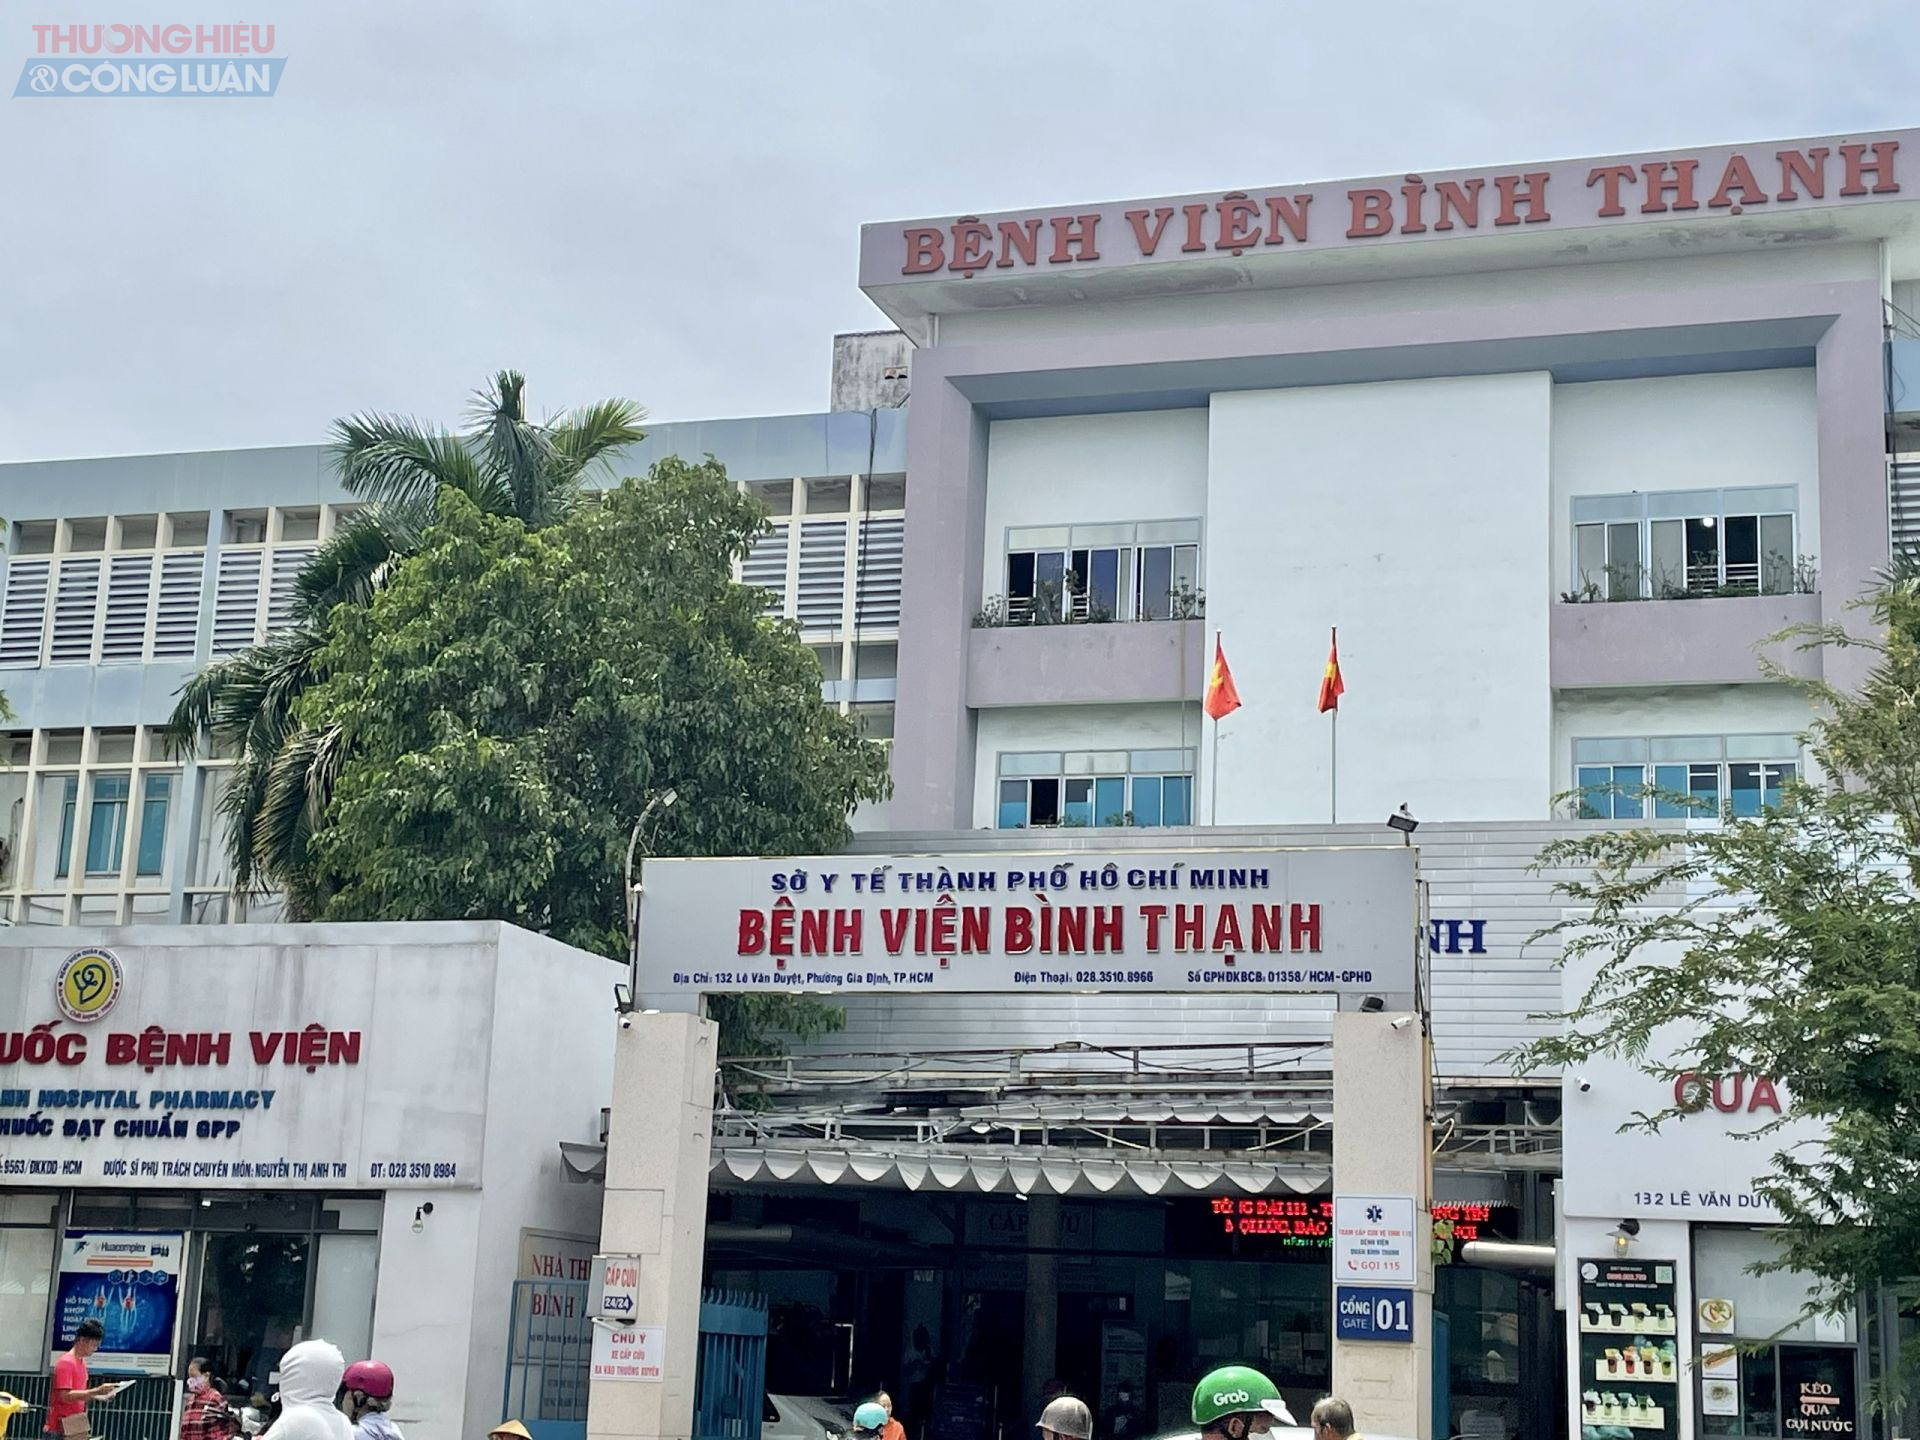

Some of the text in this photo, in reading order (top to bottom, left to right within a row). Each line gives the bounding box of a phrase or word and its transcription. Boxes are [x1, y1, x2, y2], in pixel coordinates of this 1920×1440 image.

[902, 140, 1900, 279] BỆNH VIỆN BÌNH THẠNH
[820, 872, 838, 893] Y
[898, 866, 997, 893] THÀNH
[1007, 862, 1074, 890] PHỐ
[1127, 862, 1185, 890] CHÍ
[1189, 868, 1269, 889] MINH
[737, 893, 1323, 969] BỆNH VIỆN BÌNH THẠNH
[715, 972, 733, 983] 132
[846, 972, 863, 984] Gia
[1014, 971, 1037, 984] Điện
[1075, 971, 1154, 984] 028.3510.8966
[105, 1025, 232, 1074] BỆNH
[249, 1023, 362, 1074] VIỆN
[38, 1089, 140, 1109] HOSPITAL
[149, 1090, 276, 1110] PHARMACY
[63, 1119, 106, 1142] ĐẠT
[114, 1112, 189, 1138] CHUẨN
[196, 1120, 241, 1139] GPP
[103, 1157, 127, 1179] DƯỢC
[141, 1161, 158, 1179] PHỤ
[162, 1158, 191, 1177] TRÁCH
[193, 1158, 228, 1178] CHUYÊN
[293, 1162, 308, 1180] THỊ
[310, 1162, 329, 1178] ANH
[332, 1162, 347, 1178] THI
[370, 1162, 386, 1178] ĐT:
[389, 1162, 407, 1178] 028
[409, 1162, 431, 1178] 3510
[433, 1162, 456, 1178] 8984
[1634, 1192, 1664, 1206] 132
[1670, 1190, 1692, 1206] LÊ
[1699, 1191, 1732, 1208] VĂN
[605, 1264, 638, 1288] CẤP CỨU
[1360, 1261, 1400, 1271] GỌI 115
[604, 1297, 629, 1309] 24/24
[1340, 1294, 1371, 1315] CỔNG
[1342, 1318, 1368, 1329] GATE
[1376, 1298, 1409, 1331] 01
[1213, 1389, 1249, 1406] Grab
[1800, 1404, 1830, 1416] QUA
[1785, 1417, 1853, 1432] GỌI NƯỚC
